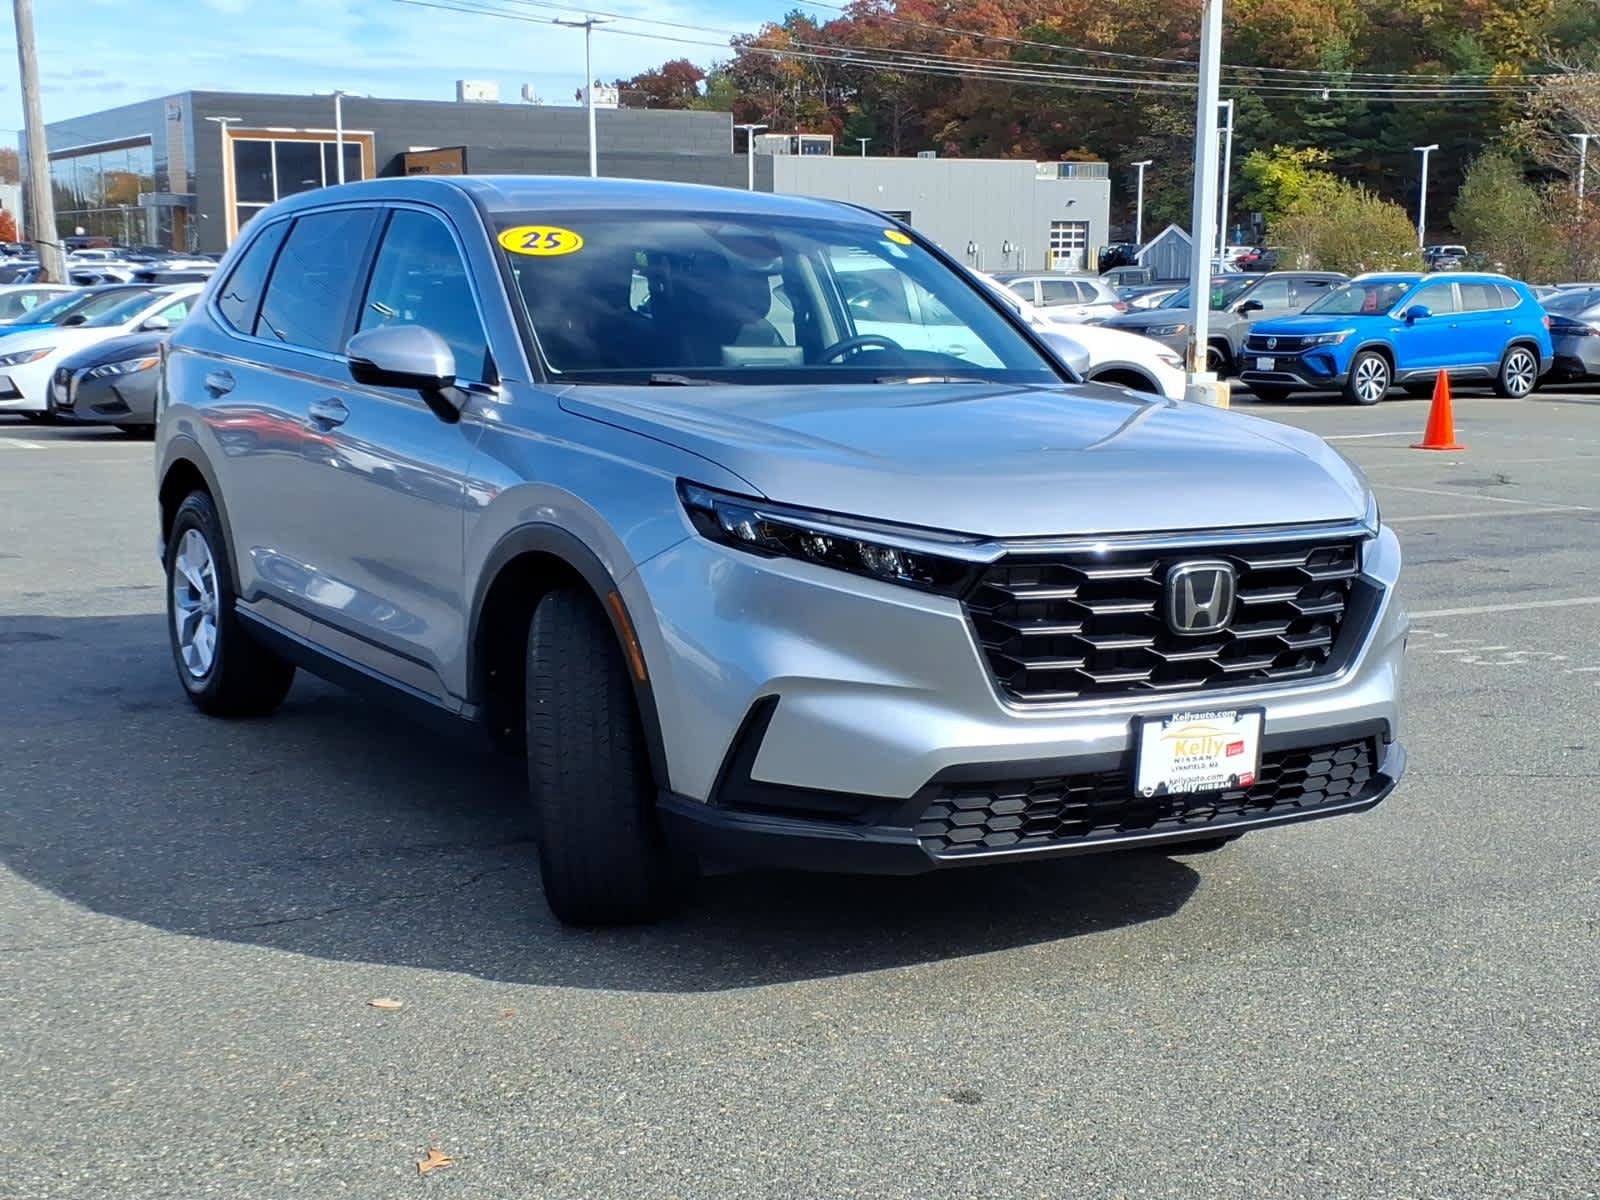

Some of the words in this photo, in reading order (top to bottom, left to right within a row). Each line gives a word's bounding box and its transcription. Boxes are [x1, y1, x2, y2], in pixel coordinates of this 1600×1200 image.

[520, 231, 562, 249] 25
[1175, 736, 1223, 757] Kelly
[1174, 756, 1212, 764] NISSAN
[1169, 774, 1224, 785] kellyauto.com
[1168, 783, 1198, 794] Kelly
[1198, 781, 1232, 791] NISSAN
